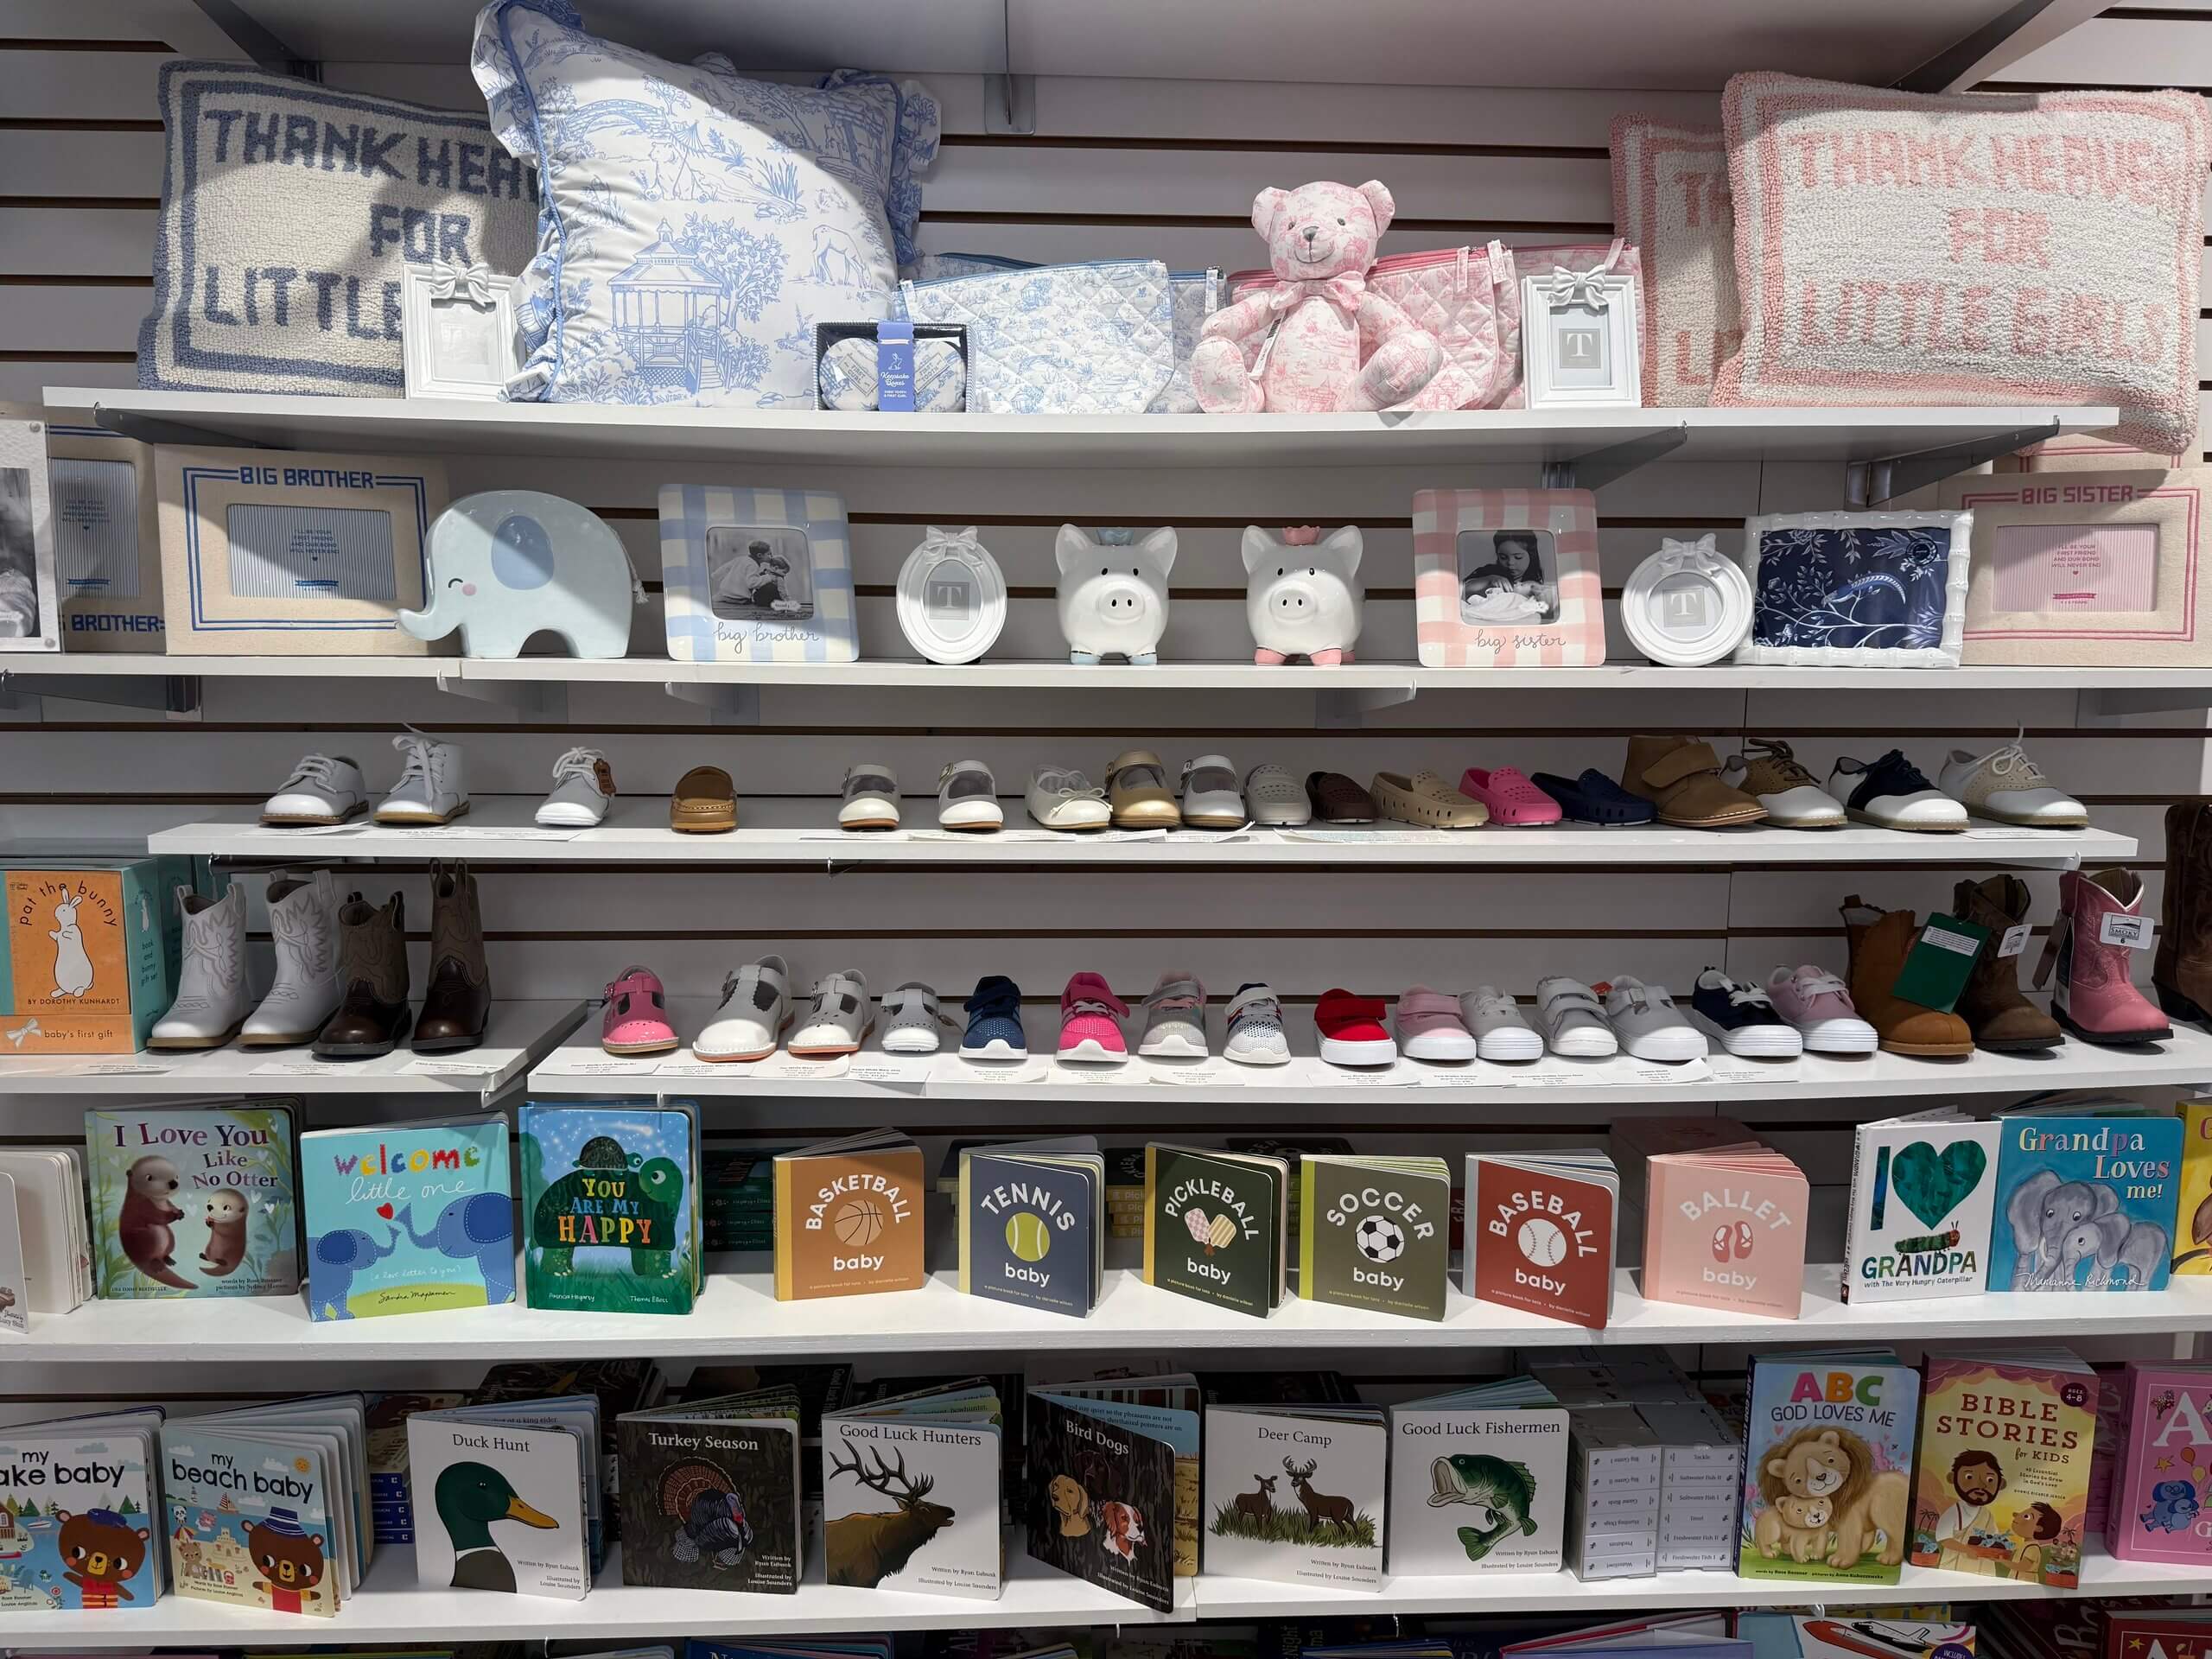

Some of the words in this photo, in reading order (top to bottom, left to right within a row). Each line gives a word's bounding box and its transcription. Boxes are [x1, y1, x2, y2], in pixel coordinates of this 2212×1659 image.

[204, 109, 406, 180] THANK
[1789, 130, 1986, 188] THANK
[370, 203, 472, 267] FOR
[1949, 207, 2051, 267] FOR
[1802, 281, 1992, 353] LITTLE
[1567, 333, 1593, 357] T
[241, 467, 277, 485] BIG
[283, 469, 374, 489] BROTHER
[2022, 486, 2056, 505] BIG
[2063, 486, 2133, 502] SISTER
[937, 586, 963, 608] T
[1670, 593, 1698, 617] T
[71, 614, 159, 632] BROTHER
[713, 622, 747, 653] big
[753, 621, 820, 642] brother
[1475, 628, 1507, 654] big
[1512, 630, 1567, 648] sister
[19, 897, 37, 926] pat
[40, 880, 67, 897] the
[78, 880, 118, 927] bunny
[2109, 927, 2139, 937] SMOKY
[44, 1030, 74, 1039] baby's
[98, 1030, 113, 1040] gift
[114, 1125, 127, 1147] I
[137, 1122, 207, 1147] Love
[214, 1124, 270, 1147] You
[2019, 1127, 2146, 1158] Grandpa
[203, 1150, 248, 1168] Like
[334, 1144, 480, 1176] welcome
[2094, 1154, 2171, 1179] Loves
[192, 1173, 220, 1189] No
[226, 1171, 278, 1187] Otter
[346, 1177, 411, 1205] little
[421, 1180, 476, 1198] one
[582, 1178, 626, 1198] YOU
[1871, 1146, 1891, 1230] I
[2126, 1184, 2164, 1199] me!
[570, 1196, 604, 1214] ARE
[612, 1199, 639, 1215] MY
[805, 1174, 911, 1230] BASKETBALL
[981, 1183, 1075, 1231] TENNIS
[1165, 1178, 1259, 1240] PICKLEBALL
[1326, 1187, 1434, 1240] SOCCER
[1680, 1188, 1792, 1230] BALLET
[558, 1216, 652, 1244] HAPPY
[1489, 1190, 1598, 1257] BASEBALL
[833, 1254, 884, 1272] baby
[1005, 1262, 1050, 1287] baby
[1187, 1257, 1231, 1286] baby
[1861, 1250, 1977, 1279] GRANDPA
[1353, 1267, 1404, 1292] baby
[1516, 1268, 1566, 1296] baby
[1703, 1267, 1757, 1290] baby
[1864, 1280, 1879, 1288] with
[1882, 1279, 1893, 1287] The
[1895, 1280, 1910, 1288] Very
[1912, 1277, 1935, 1287] Hungry
[1937, 1275, 1973, 1285] Caterpillar
[378, 1292, 410, 1304] Sandra
[1790, 1371, 1885, 1407] ABC
[2067, 1393, 2083, 1402] 4-8
[1771, 1405, 1807, 1422] GOD
[1815, 1405, 1864, 1422] LOVES
[1868, 1411, 1896, 1427] ME
[1961, 1393, 2058, 1422] BIBLE
[840, 1424, 878, 1438] Good
[884, 1427, 918, 1441] Luck
[923, 1430, 982, 1446] Hunters
[1065, 1420, 1092, 1441] Bird
[1096, 1432, 1129, 1455] Dogs
[1258, 1427, 1289, 1440] Deer
[1293, 1431, 1332, 1448] Camp
[1402, 1422, 1440, 1435] Good
[1446, 1421, 1480, 1435] Luck
[1485, 1421, 1561, 1434] Fishermen
[1936, 1415, 2078, 1449] STORIES
[453, 1433, 489, 1448] Duck
[493, 1437, 531, 1452] Hunt
[649, 1433, 702, 1451] Turkey
[705, 1435, 759, 1450] Season
[22, 1451, 49, 1465] my
[211, 1453, 233, 1469] my
[2015, 1446, 2028, 1460] for
[2032, 1451, 2069, 1464] KIDS
[54, 1462, 124, 1488] baby
[172, 1459, 247, 1491] beach
[254, 1471, 314, 1504] baby
[1296, 1570, 1324, 1579] Illustrated
[1340, 1561, 1355, 1570] Ryan
[972, 1582, 997, 1591] Saunders
[1136, 1573, 1149, 1585] Ryan
